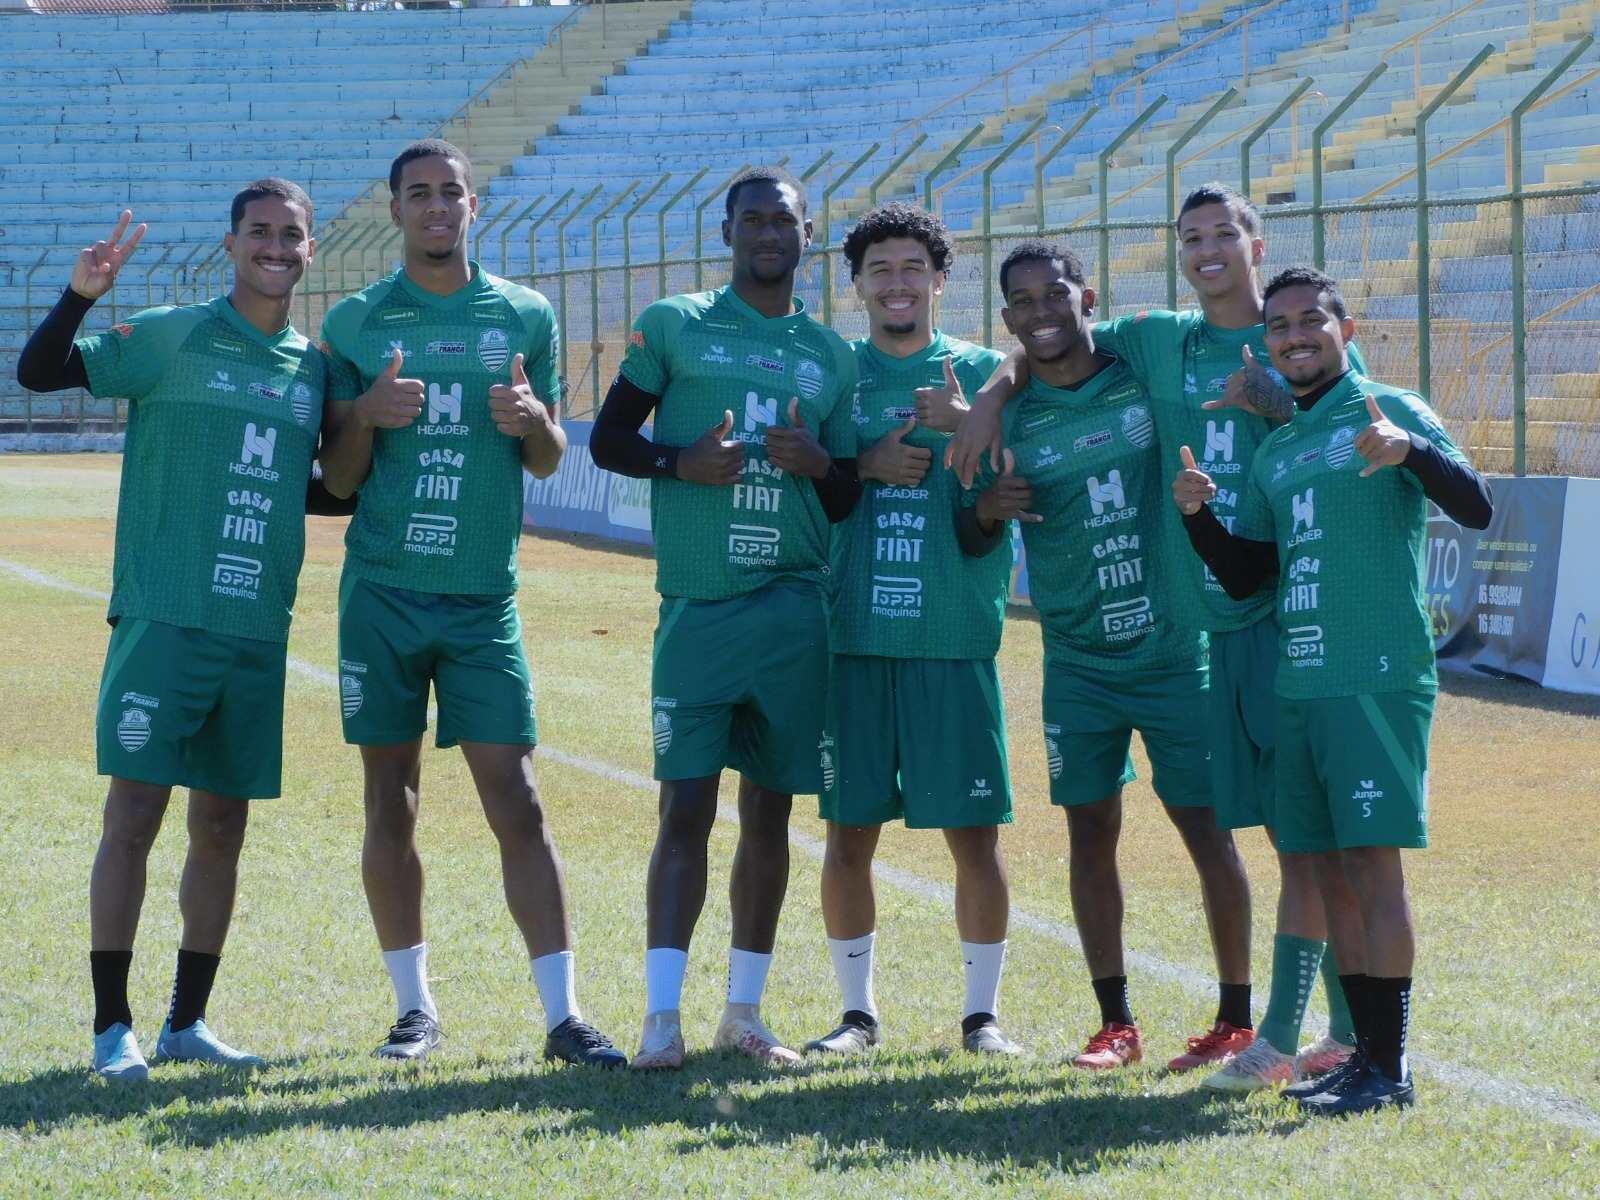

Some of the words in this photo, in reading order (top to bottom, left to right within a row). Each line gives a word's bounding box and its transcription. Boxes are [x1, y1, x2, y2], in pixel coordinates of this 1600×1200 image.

[381, 350, 412, 358] Jue
[701, 353, 733, 364] Junpe
[759, 361, 784, 372] FRANCA
[207, 380, 236, 392] Junpe
[417, 424, 469, 435] HEADER
[1086, 434, 1111, 447] FRANCA
[419, 448, 465, 469] CASA
[1034, 452, 1062, 469] Junpe
[228, 462, 279, 482] HEADER
[414, 474, 463, 500] FIAT
[876, 488, 929, 499] HEADER
[227, 490, 273, 514] CASA
[732, 483, 783, 512] FIAT
[876, 512, 926, 531] CASA
[1083, 506, 1138, 530] HEADER
[222, 514, 268, 545] FIAT
[404, 543, 455, 556] maquinas
[876, 537, 924, 562] FIAT
[1092, 534, 1140, 559] CASA
[728, 555, 777, 567] maquinas
[1097, 557, 1143, 591] FIAT
[211, 585, 257, 600] maquinas
[1284, 582, 1320, 613] FIAT
[872, 606, 921, 619] maquinas
[1105, 624, 1155, 642] maquinas
[969, 788, 992, 798] Junpe
[1352, 790, 1383, 800] Junpe
